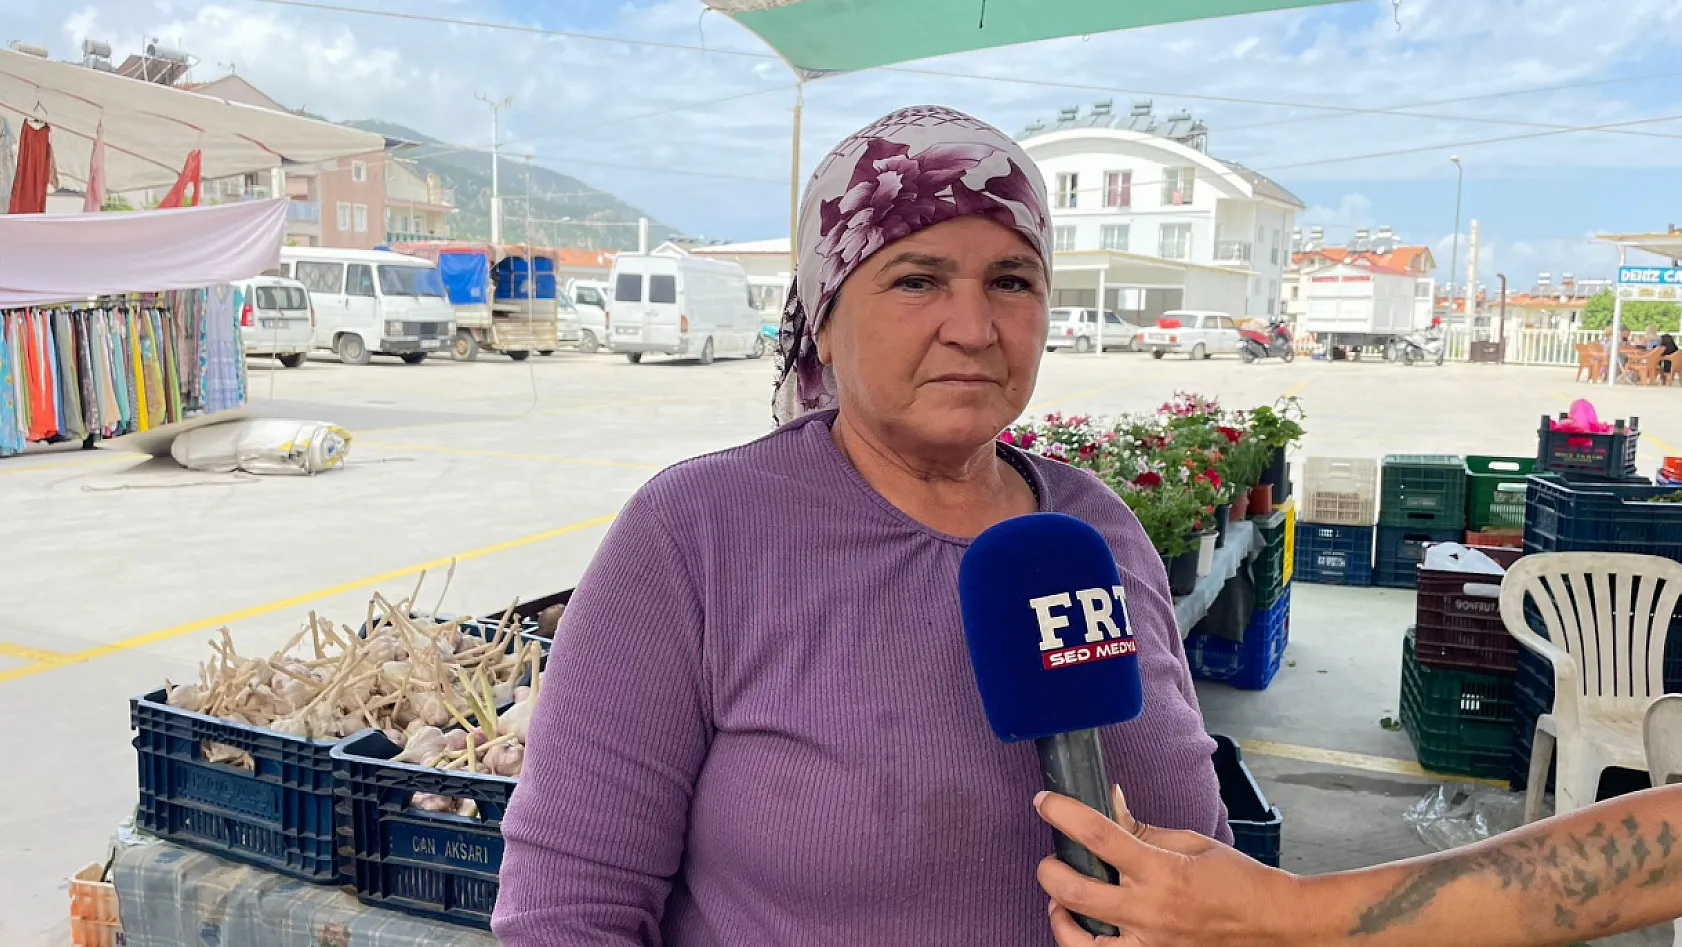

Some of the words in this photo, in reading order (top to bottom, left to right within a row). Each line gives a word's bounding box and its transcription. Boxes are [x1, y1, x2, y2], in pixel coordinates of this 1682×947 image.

[1049, 647, 1091, 666] SED
[412, 835, 436, 855] CAN
[445, 840, 489, 864] AKSARI
